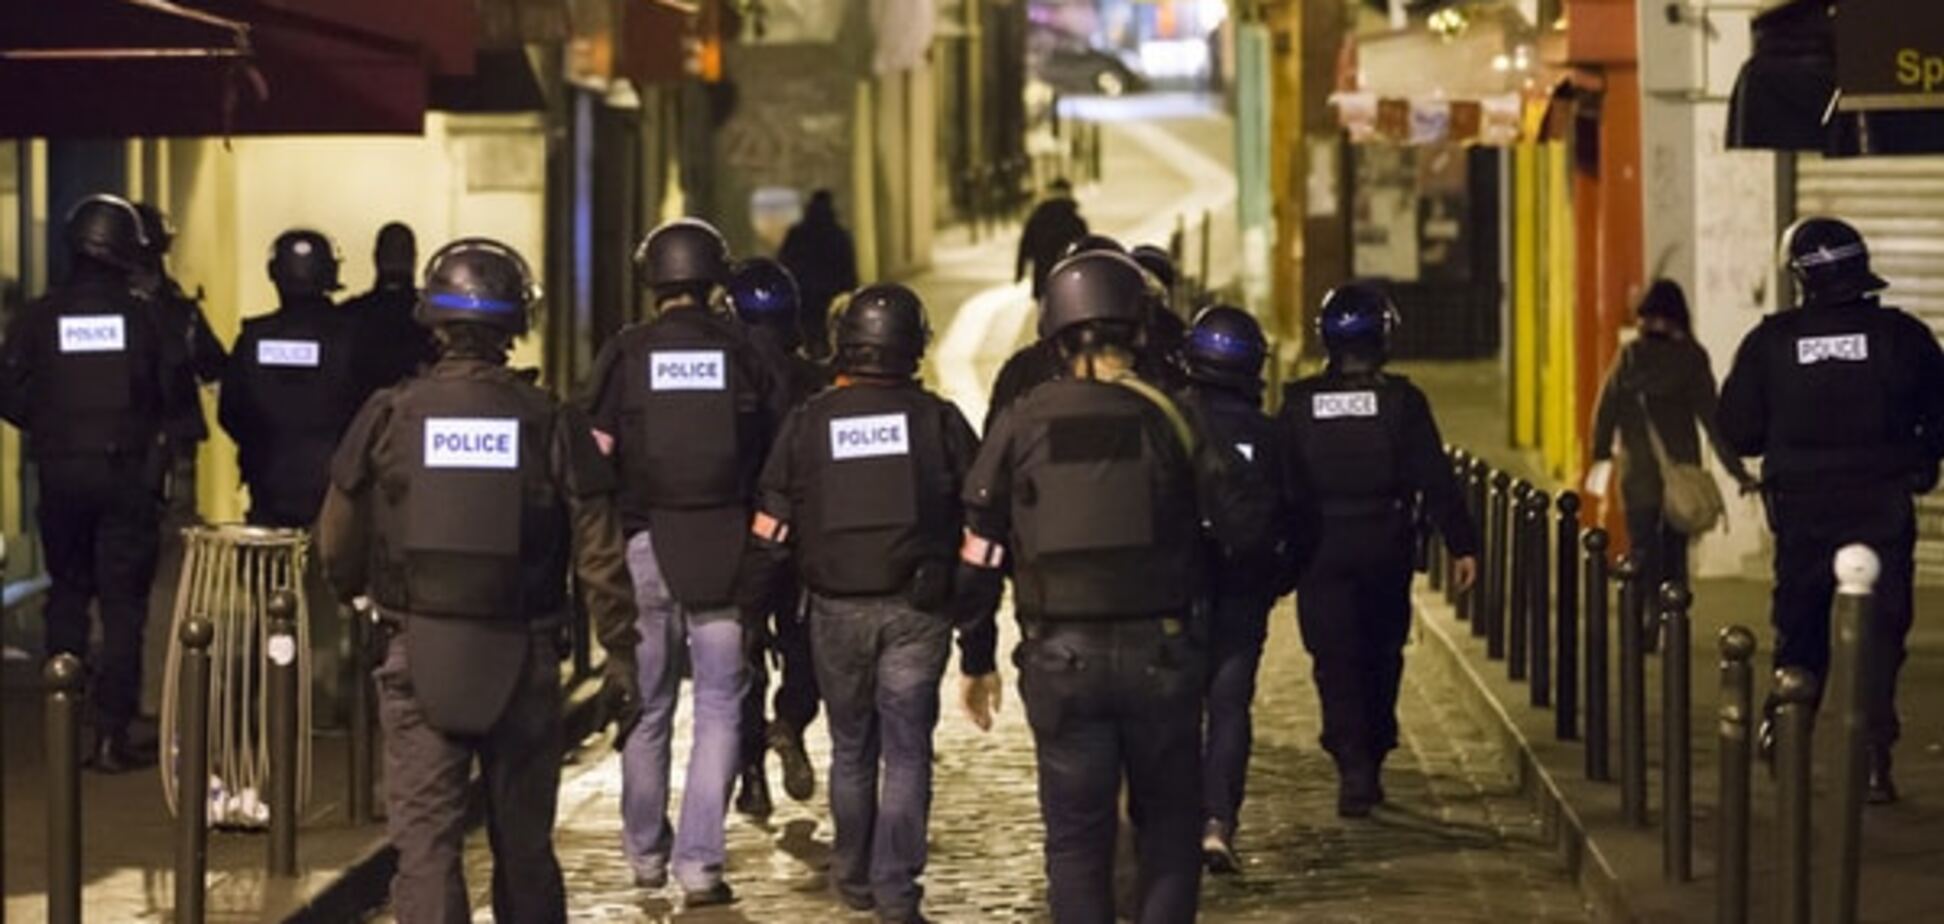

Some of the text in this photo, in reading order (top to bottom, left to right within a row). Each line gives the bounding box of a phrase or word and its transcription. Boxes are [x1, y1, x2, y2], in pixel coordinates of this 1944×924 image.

[66, 325, 117, 342] POLICE
[1801, 338, 1864, 359] POLICE
[656, 361, 718, 379] POLICE
[1317, 397, 1374, 414] POLICE
[432, 433, 511, 453] POLICE
[836, 425, 901, 446] POLICE
